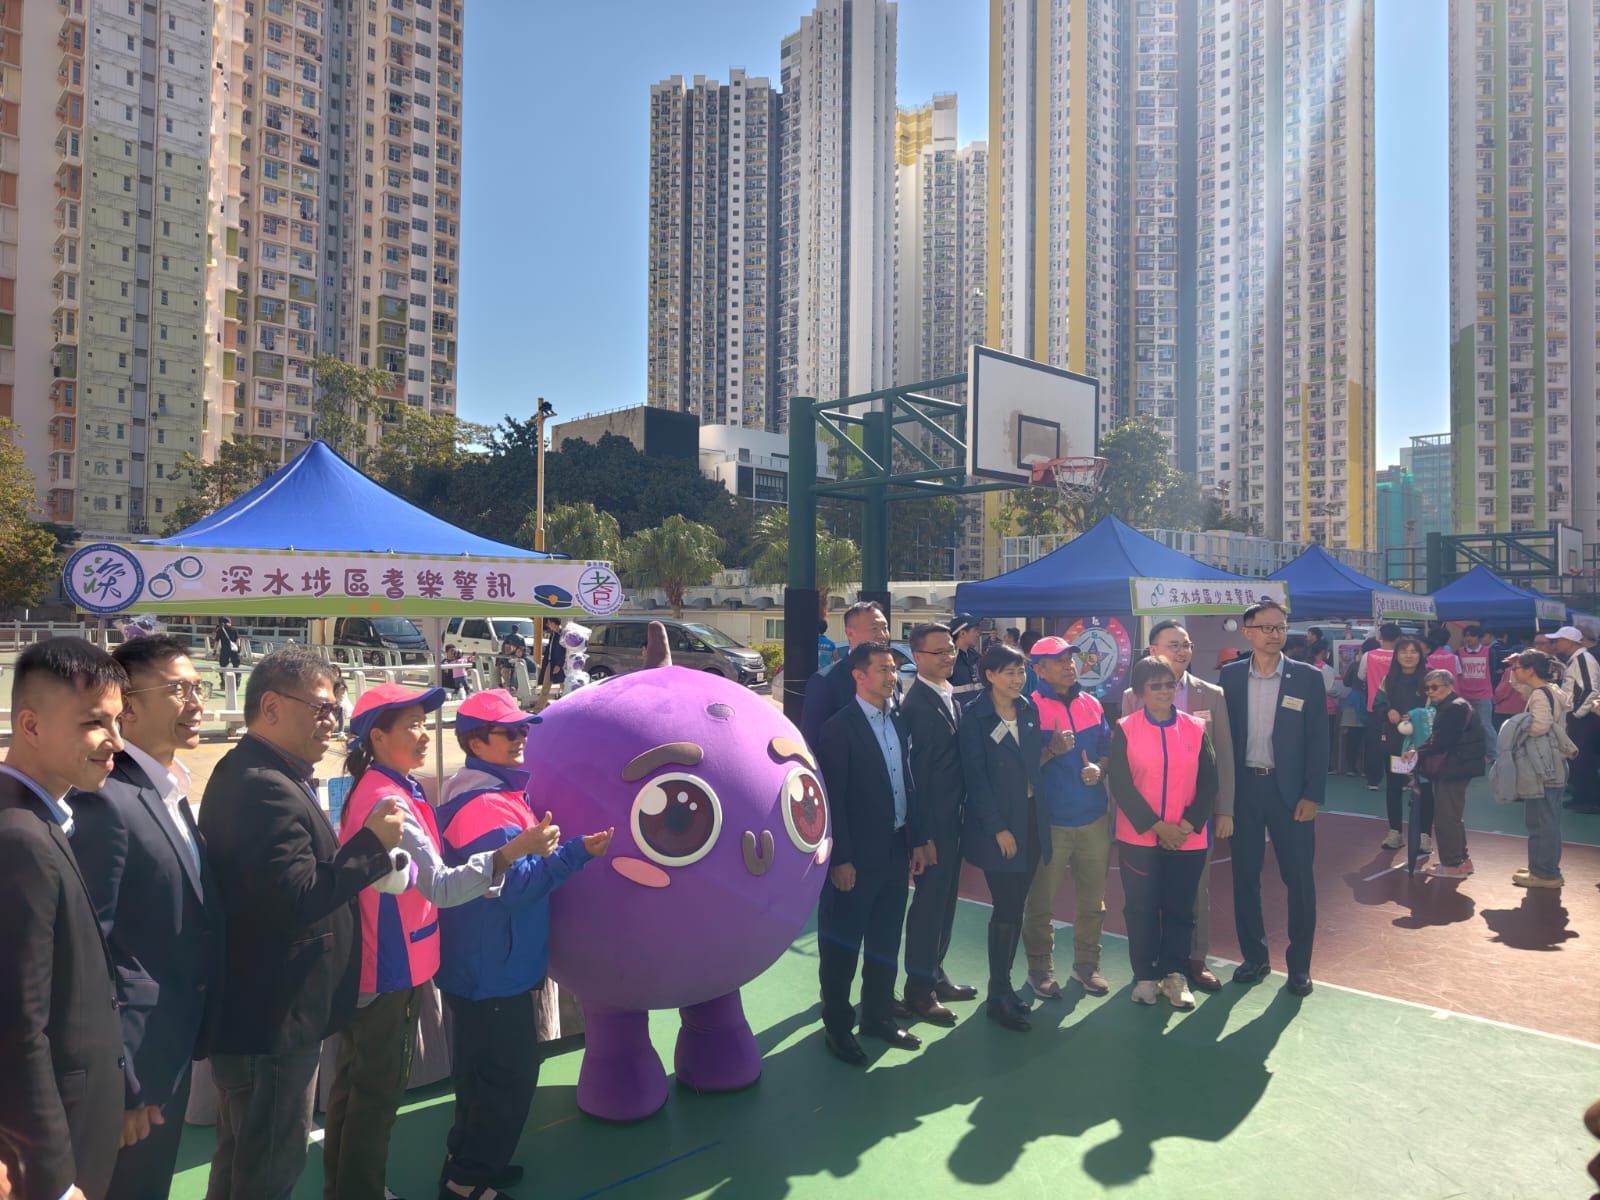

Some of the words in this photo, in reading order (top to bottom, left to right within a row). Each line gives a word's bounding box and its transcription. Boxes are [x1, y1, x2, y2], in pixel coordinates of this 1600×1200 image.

[221, 565, 516, 601] 深水埗區耆樂警訊
[1169, 587, 1256, 606] 深水埗區少年警訊
